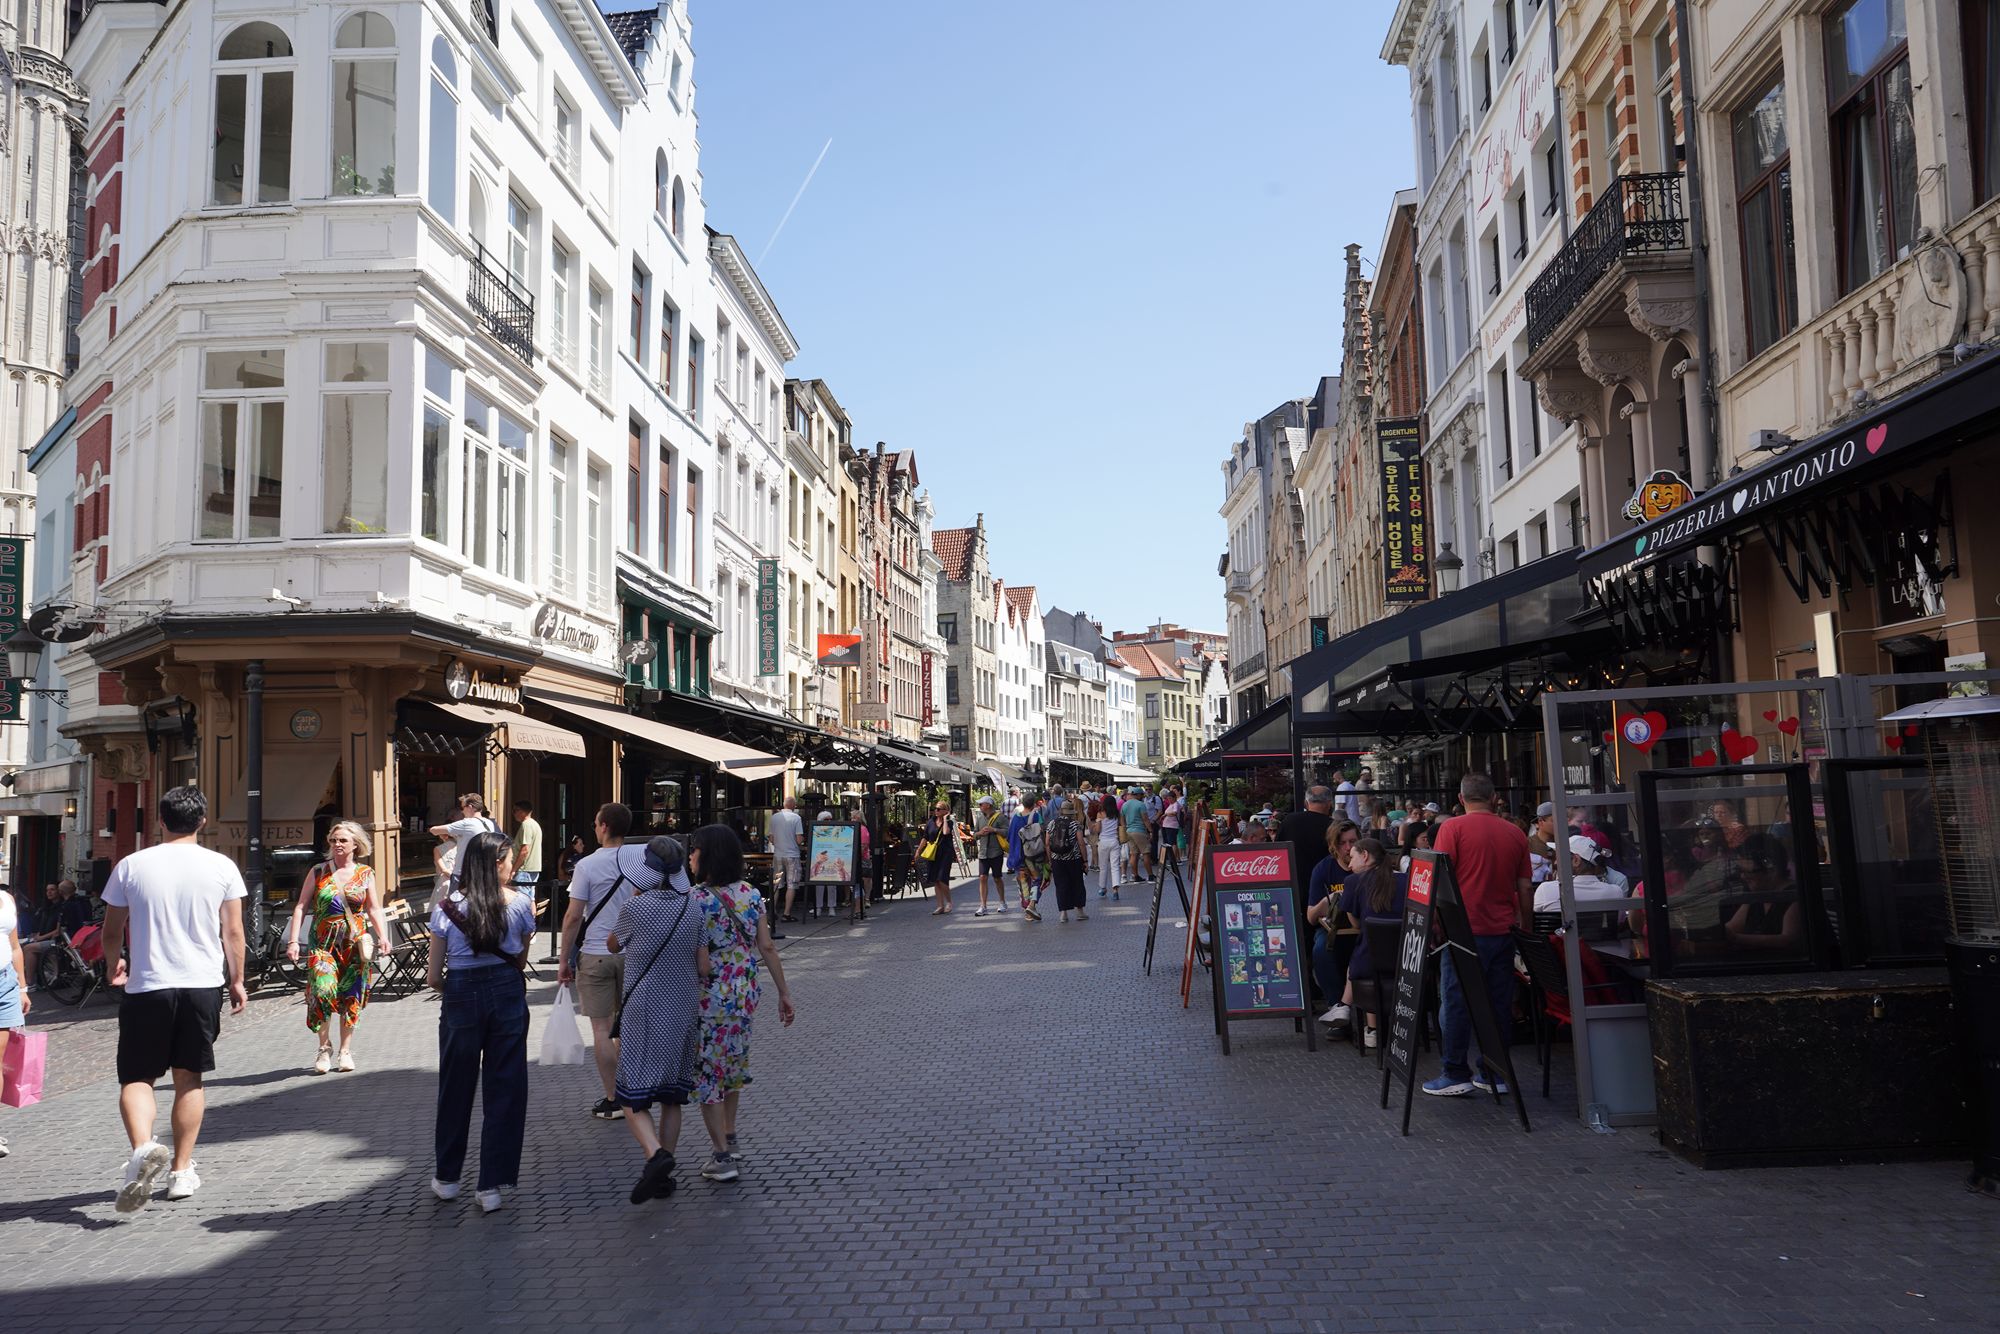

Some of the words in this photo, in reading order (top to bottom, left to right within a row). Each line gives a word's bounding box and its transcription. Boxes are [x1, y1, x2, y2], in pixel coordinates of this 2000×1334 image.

[1380, 427, 1418, 437] ARGENTIJNS
[1408, 464, 1420, 481] EL
[1385, 464, 1400, 513] STEAK
[1408, 486, 1422, 517] TORO
[1649, 500, 1726, 551] PIZZERIA
[1748, 440, 1856, 508] ANTONIO
[1387, 521, 1402, 569] HOUSE
[1410, 523, 1425, 562] NEGRO
[761, 563, 773, 586] DEL
[762, 588, 774, 612] SUD
[1388, 586, 1407, 594] VLEES
[1414, 584, 1424, 593] VIS
[555, 614, 600, 651] Amorino
[762, 613, 776, 674] CLASSICO
[467, 669, 520, 705] Amorino
[923, 654, 932, 726] PIZZERIA
[516, 732, 544, 745] GELATO
[1194, 760, 1220, 768] sushibar
[1568, 765, 1585, 785] TORO
[1220, 855, 1282, 877] Coca-Cola
[1237, 892, 1271, 902] COCKTAILS
[1401, 928, 1426, 974] OPEN
